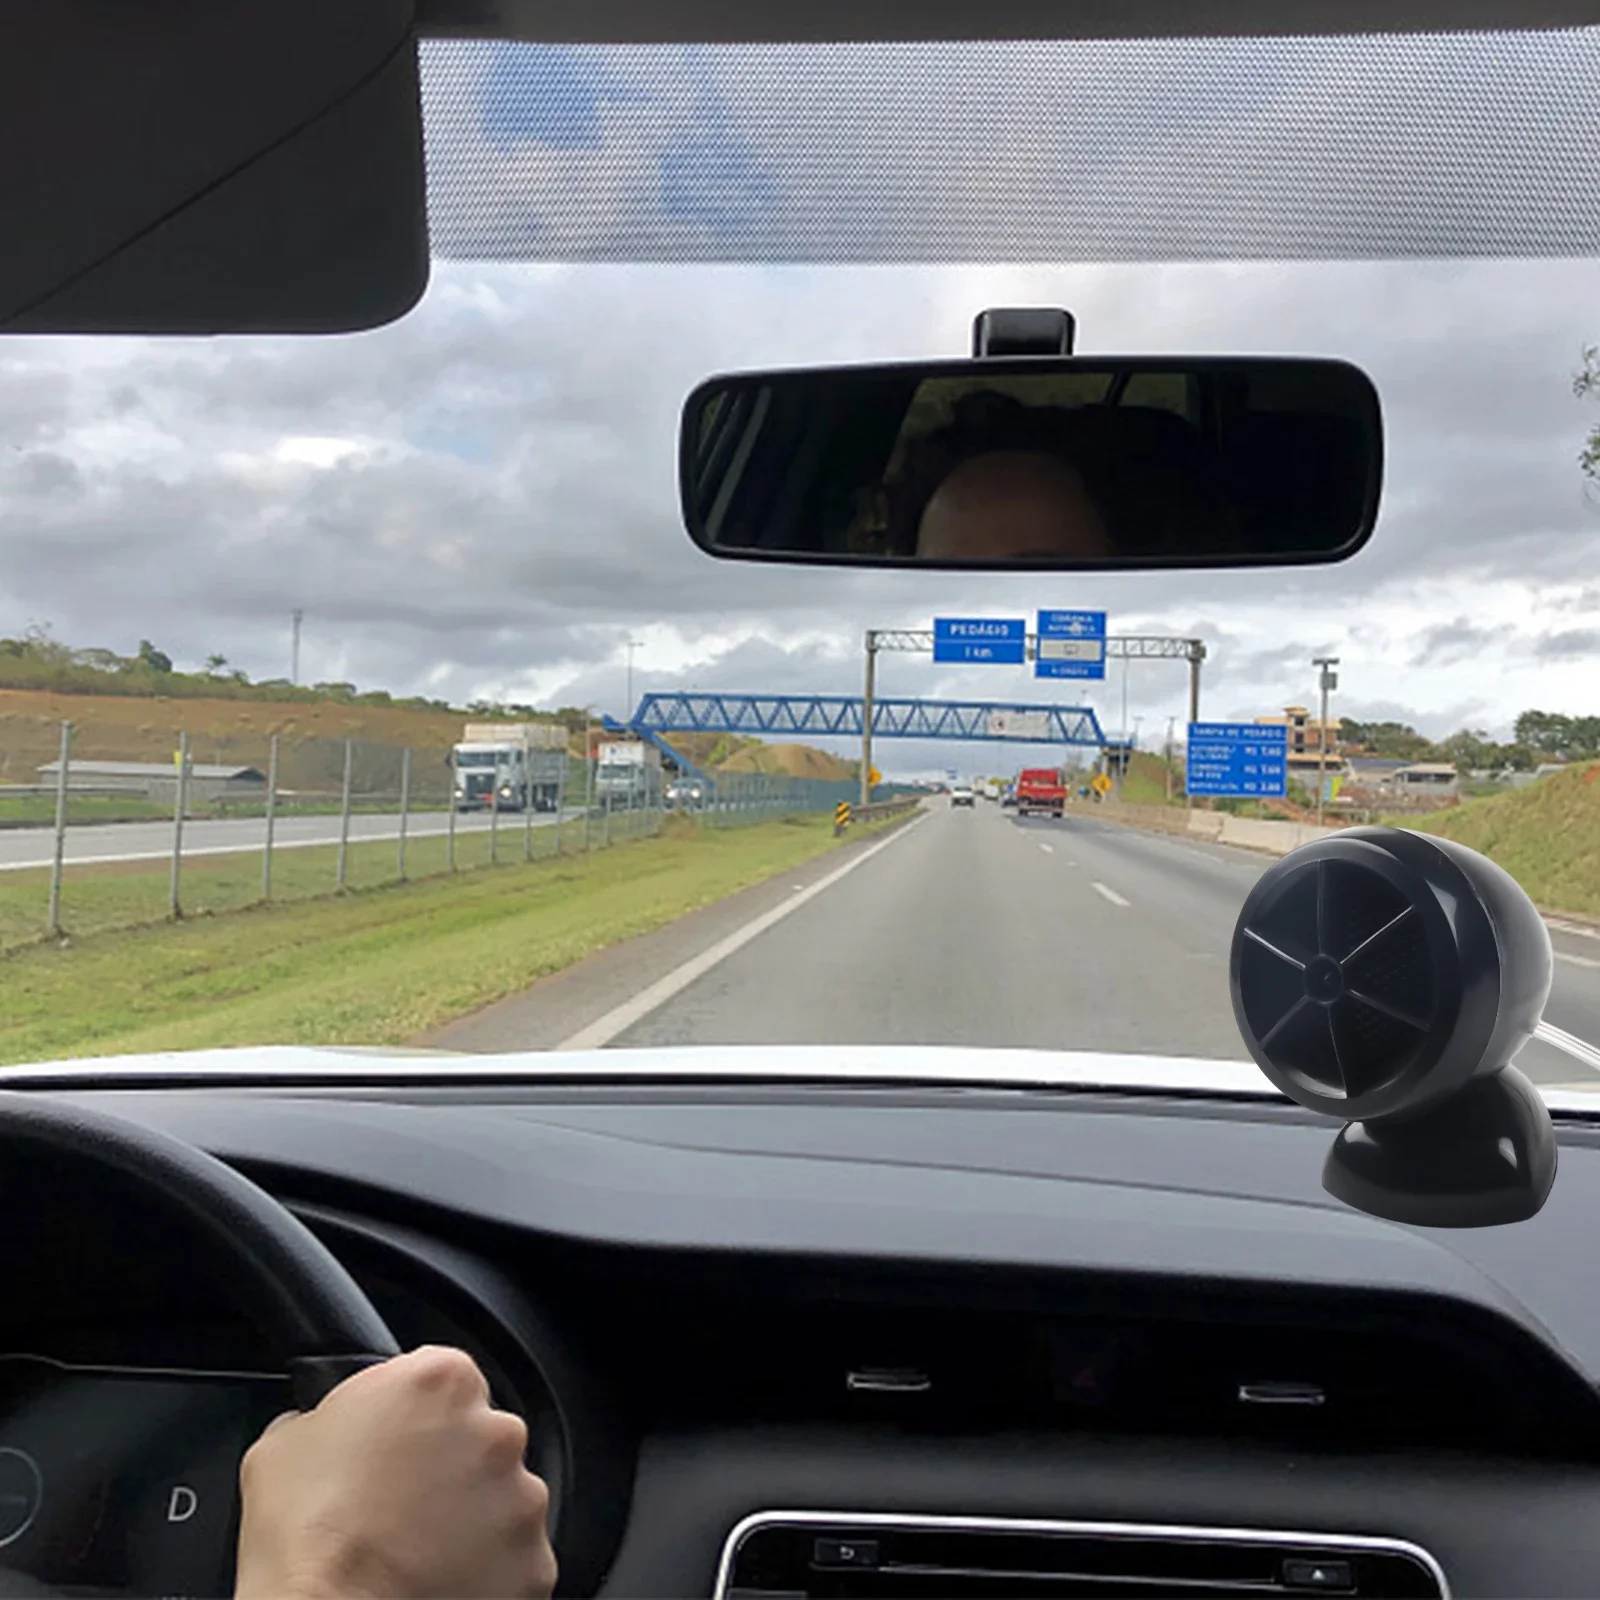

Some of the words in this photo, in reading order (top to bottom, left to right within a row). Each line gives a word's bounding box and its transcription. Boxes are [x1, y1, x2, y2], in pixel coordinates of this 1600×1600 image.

[950, 623, 1009, 636] PEDÁGIO
[973, 647, 993, 658] km
[167, 1485, 197, 1522] D
